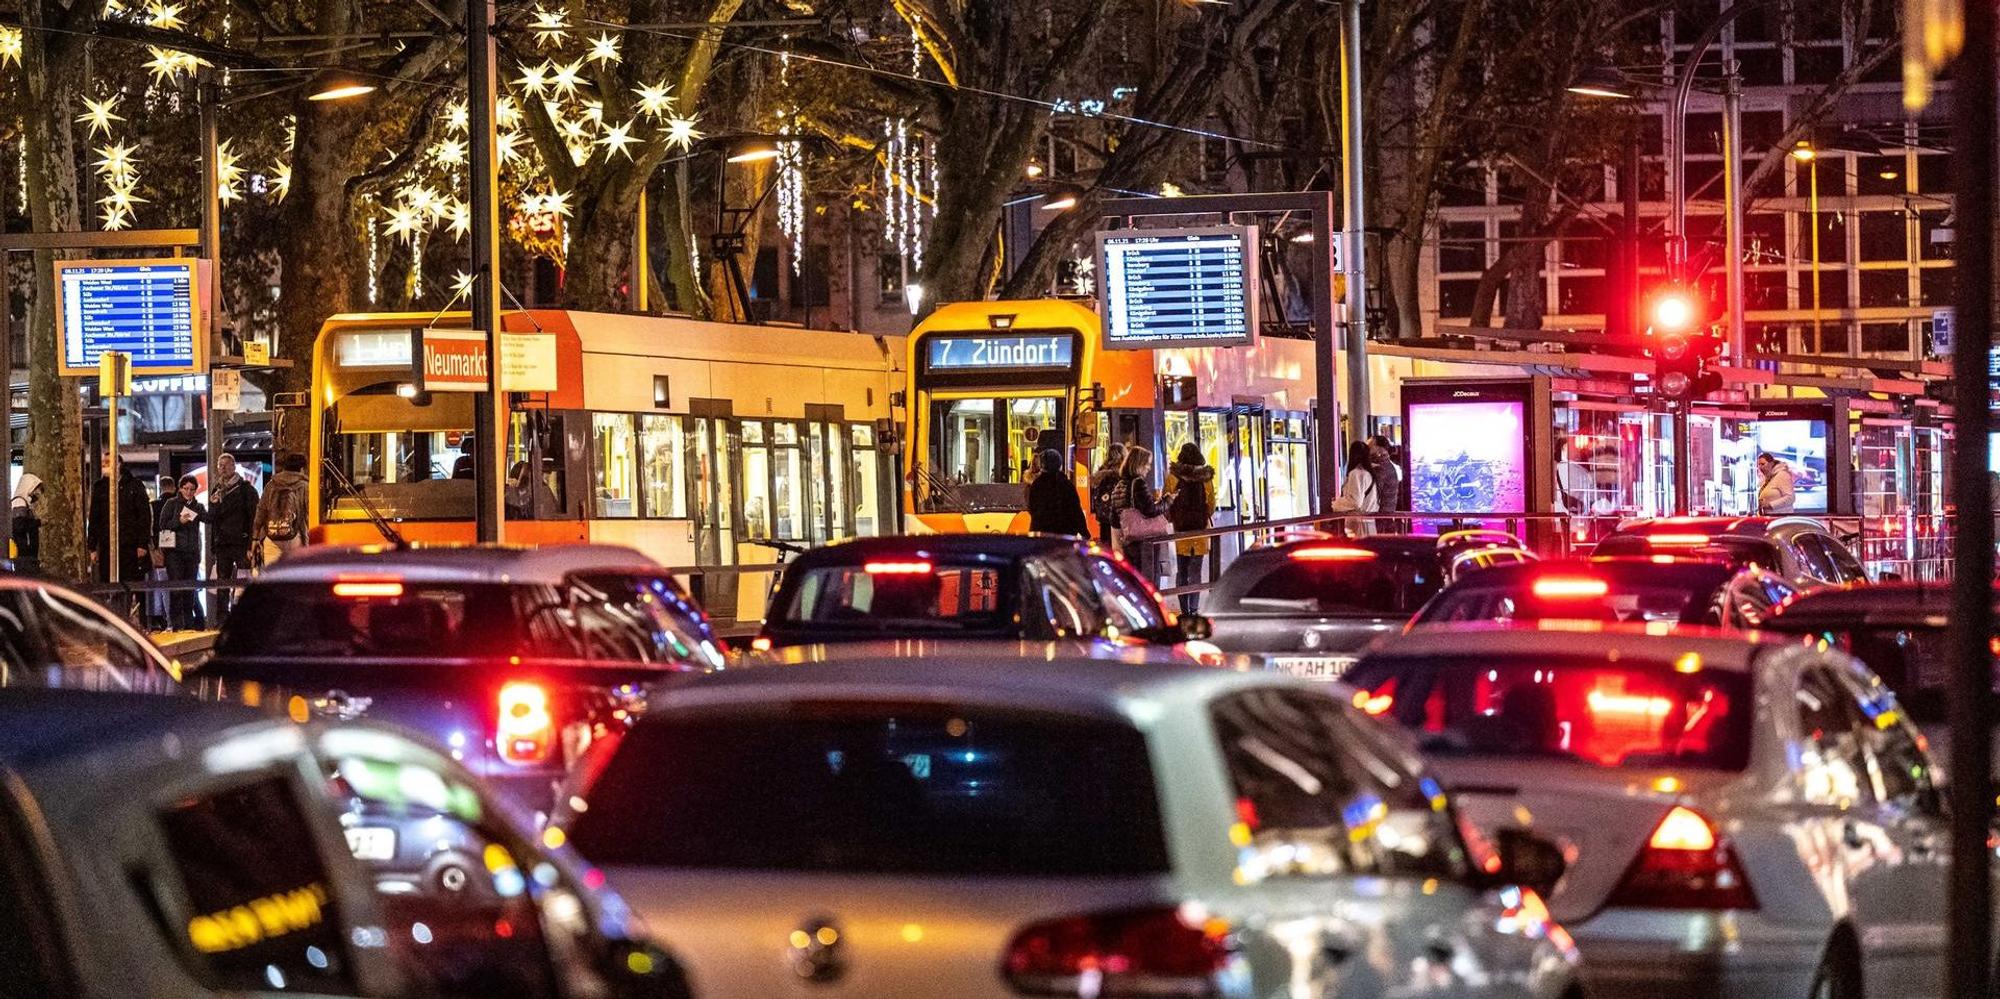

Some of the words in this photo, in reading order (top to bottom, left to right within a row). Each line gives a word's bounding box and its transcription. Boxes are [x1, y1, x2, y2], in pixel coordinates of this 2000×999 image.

[424, 345, 488, 376] Neumarkt
[940, 340, 952, 366] 7
[972, 338, 1058, 364] Zündorf
[130, 375, 207, 392] COFFEE
[1304, 660, 1326, 676] AH
